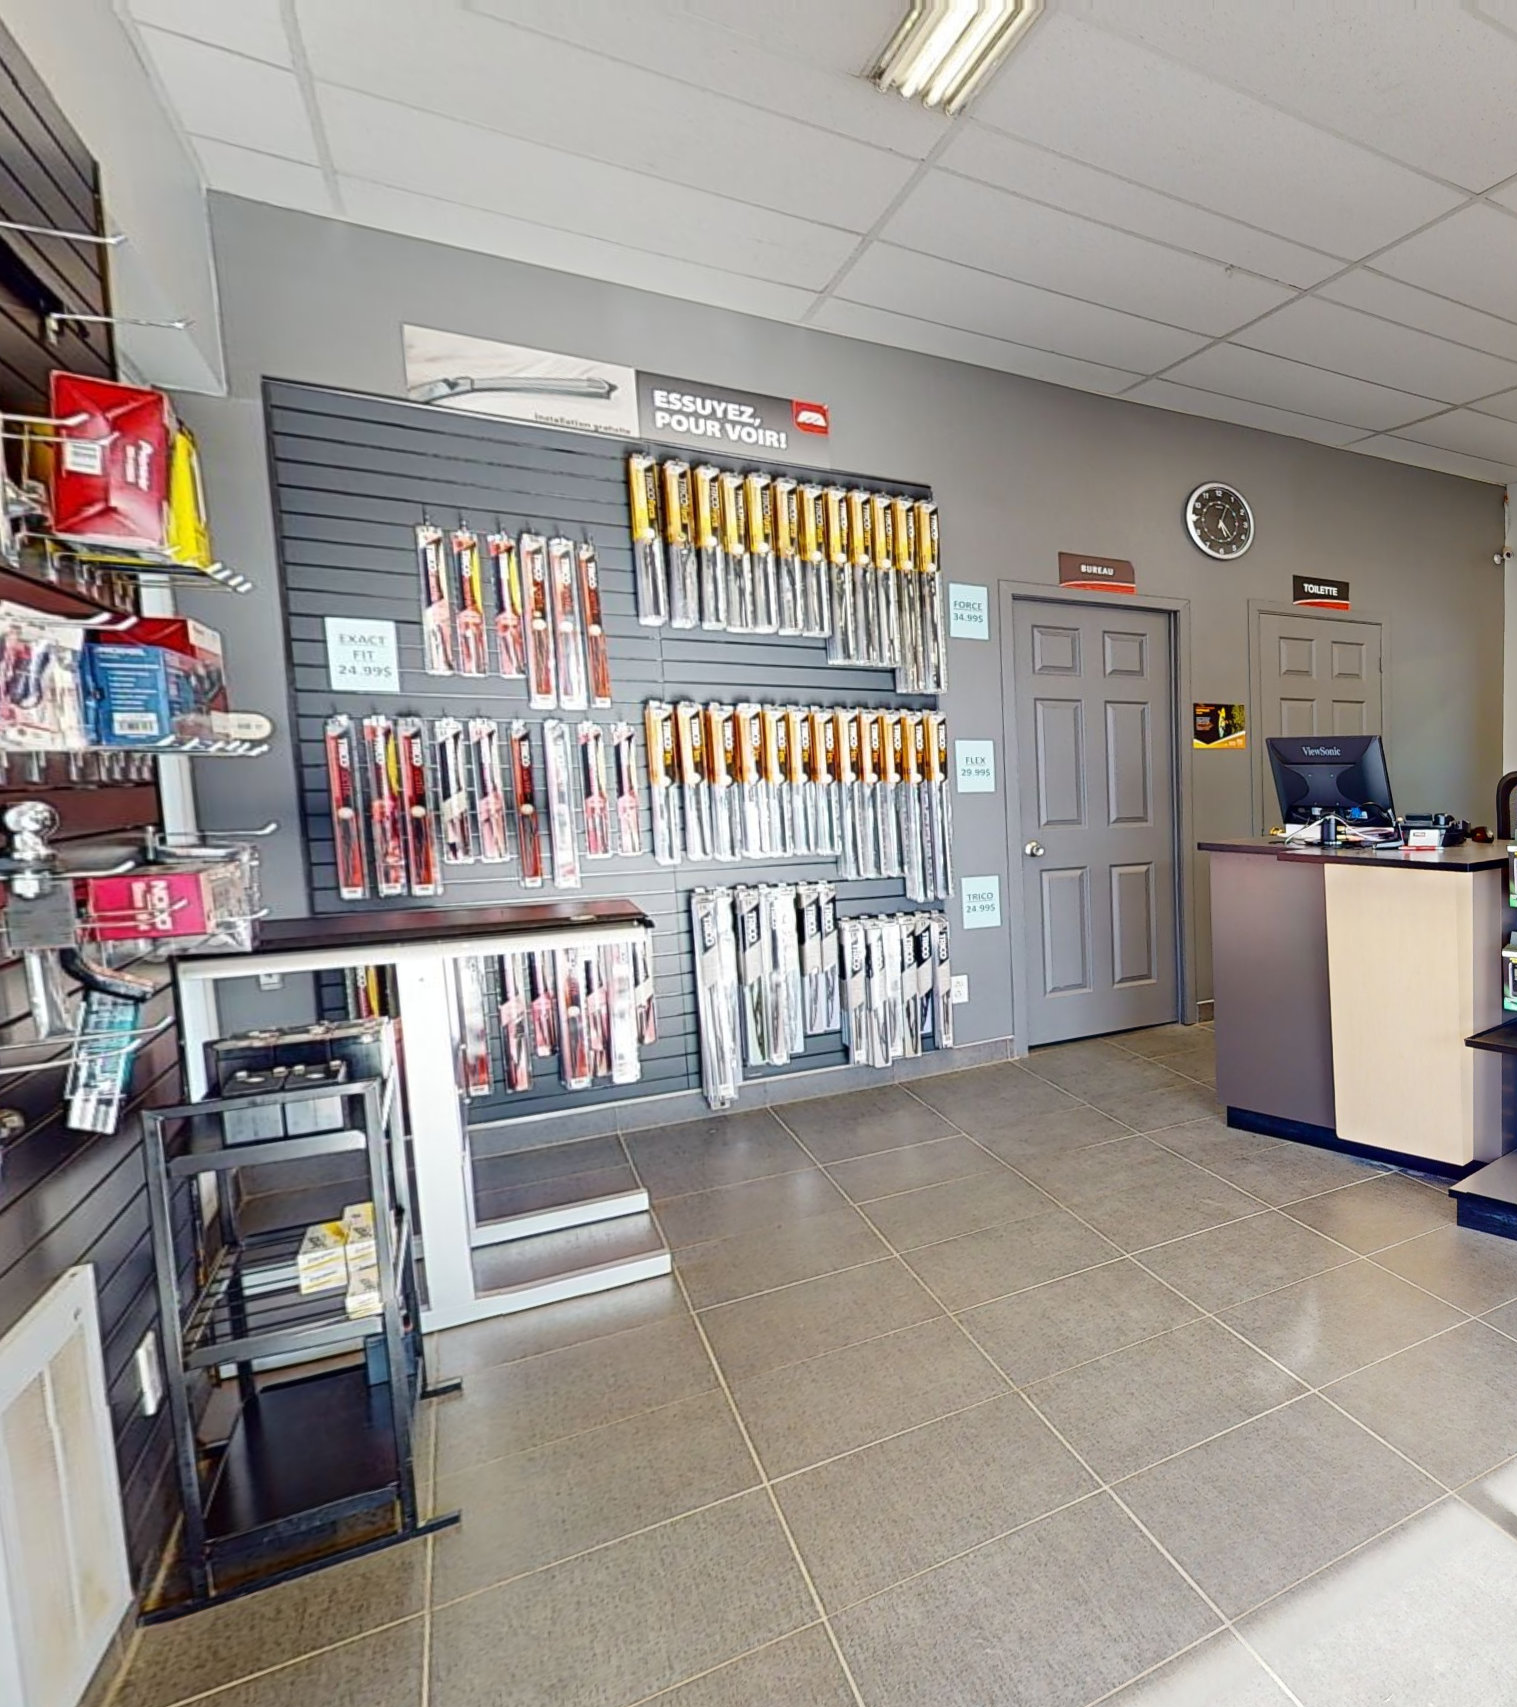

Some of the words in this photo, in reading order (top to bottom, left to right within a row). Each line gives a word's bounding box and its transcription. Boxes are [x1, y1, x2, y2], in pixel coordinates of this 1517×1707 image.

[653, 389, 762, 428] ESSUYEZ,
[655, 411, 721, 438] POUR
[725, 423, 788, 449] VOIR!
[1080, 564, 1114, 576] BUREAU
[1303, 583, 1338, 596] TOILETTE
[953, 600, 983, 610] FORCE
[340, 633, 386, 647] EXACT
[353, 650, 375, 661] FIT
[1302, 746, 1341, 757] ViewSonic
[965, 756, 986, 764] FLEX
[966, 892, 994, 901] TRICO
[921, 930, 930, 960] TRICO
[939, 933, 947, 961] TRICO
